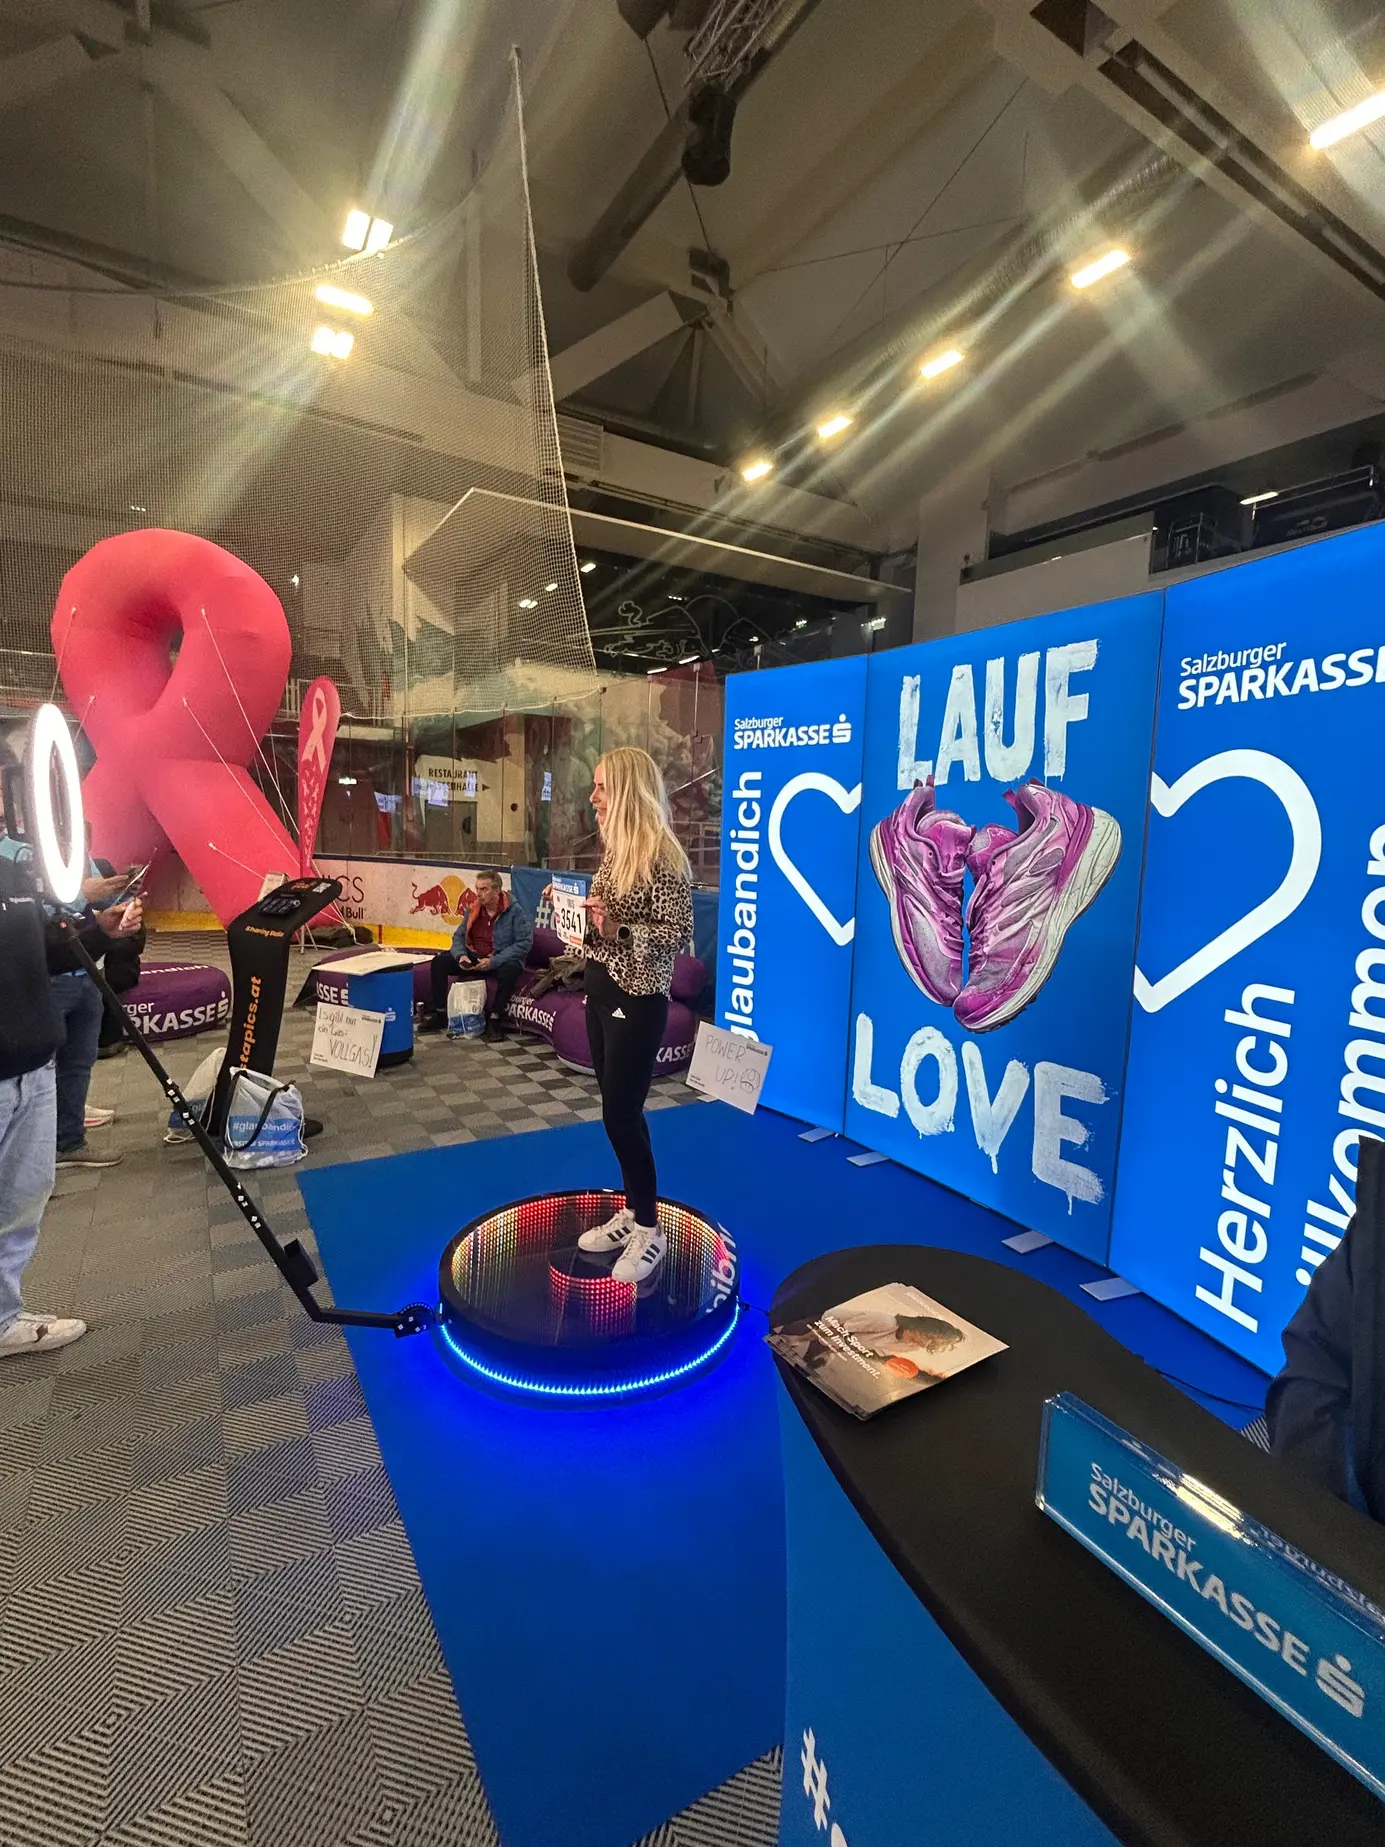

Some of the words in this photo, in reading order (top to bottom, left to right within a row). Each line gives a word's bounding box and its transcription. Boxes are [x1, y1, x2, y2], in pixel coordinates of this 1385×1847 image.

[1180, 642, 1287, 677] Salzburger
[733, 724, 830, 750] SPARKASSE
[734, 716, 783, 731] Salzburger
[897, 640, 1098, 789] LAUF
[560, 907, 582, 934] 3541
[705, 1034, 746, 1062] POWER
[852, 1012, 1111, 1215] LOVE
[1195, 983, 1296, 1333] Herzlich
[814, 1319, 837, 1342] zum
[830, 1333, 883, 1380] Investment.
[824, 1315, 850, 1341] Mach
[847, 1331, 875, 1359] Sport
[1089, 1461, 1197, 1553] Salzburger
[1088, 1482, 1312, 1677] SPARKASSE
